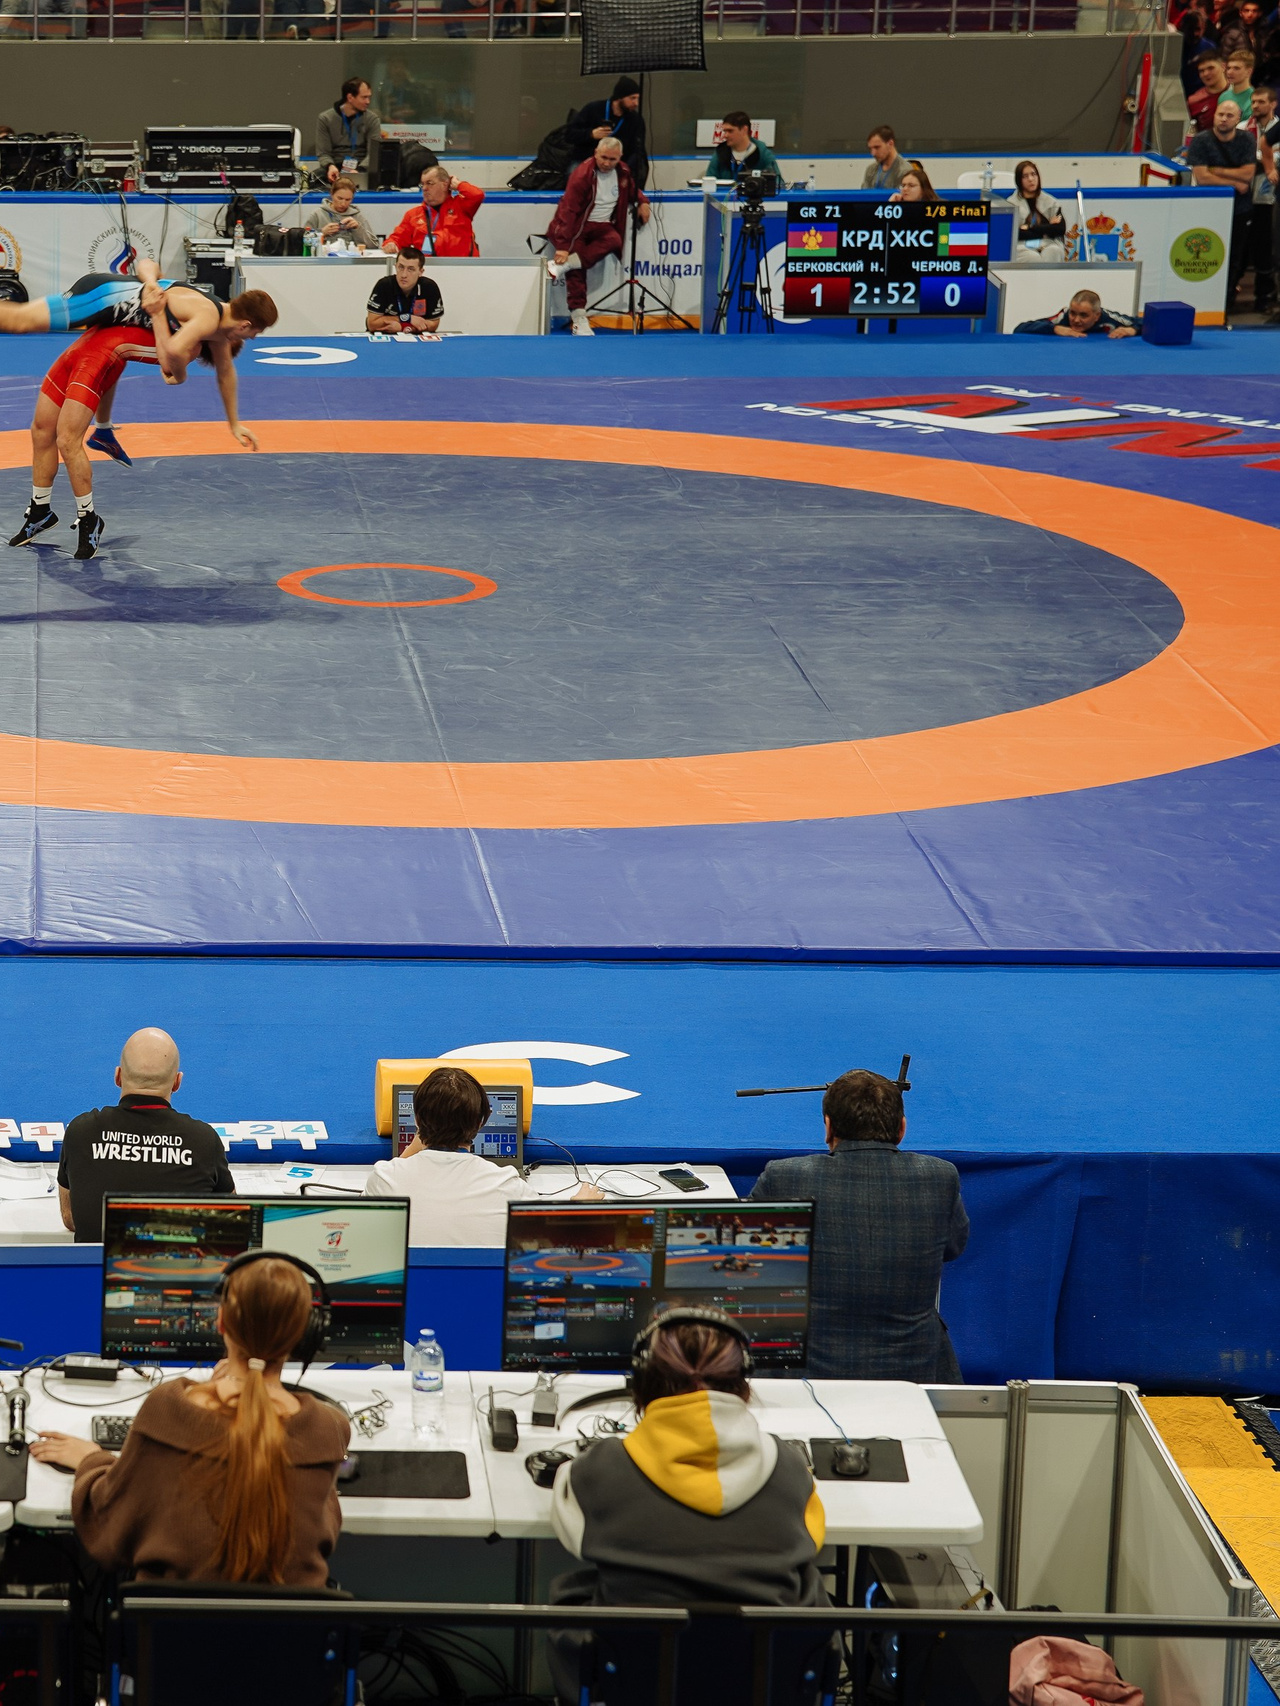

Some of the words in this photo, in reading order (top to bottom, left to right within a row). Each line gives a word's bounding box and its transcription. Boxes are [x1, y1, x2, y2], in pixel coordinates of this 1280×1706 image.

[800, 206, 817, 218] GR
[825, 205, 841, 218] 71
[875, 205, 902, 219] 460
[925, 206, 947, 218] 1/8
[953, 205, 987, 217] Final
[841, 230, 884, 250] КРД
[890, 229, 934, 247] ХКС
[658, 239, 692, 255] ООО
[788, 260, 864, 272] БЕРКОВСКИЙ
[870, 262, 884, 273] Н.
[912, 261, 961, 272] ЧЕРНОВ
[967, 261, 983, 274] Д.
[810, 283, 823, 307] 1
[853, 282, 916, 305] 2:52
[944, 283, 961, 307] 0
[31, 1125, 57, 1136] 1
[249, 1124, 276, 1134] 2
[291, 1124, 319, 1134] 4
[102, 1131, 140, 1144] UNITED
[142, 1135, 183, 1146] WORLD
[92, 1143, 193, 1165] WRESTLING
[286, 1167, 314, 1178] 5
